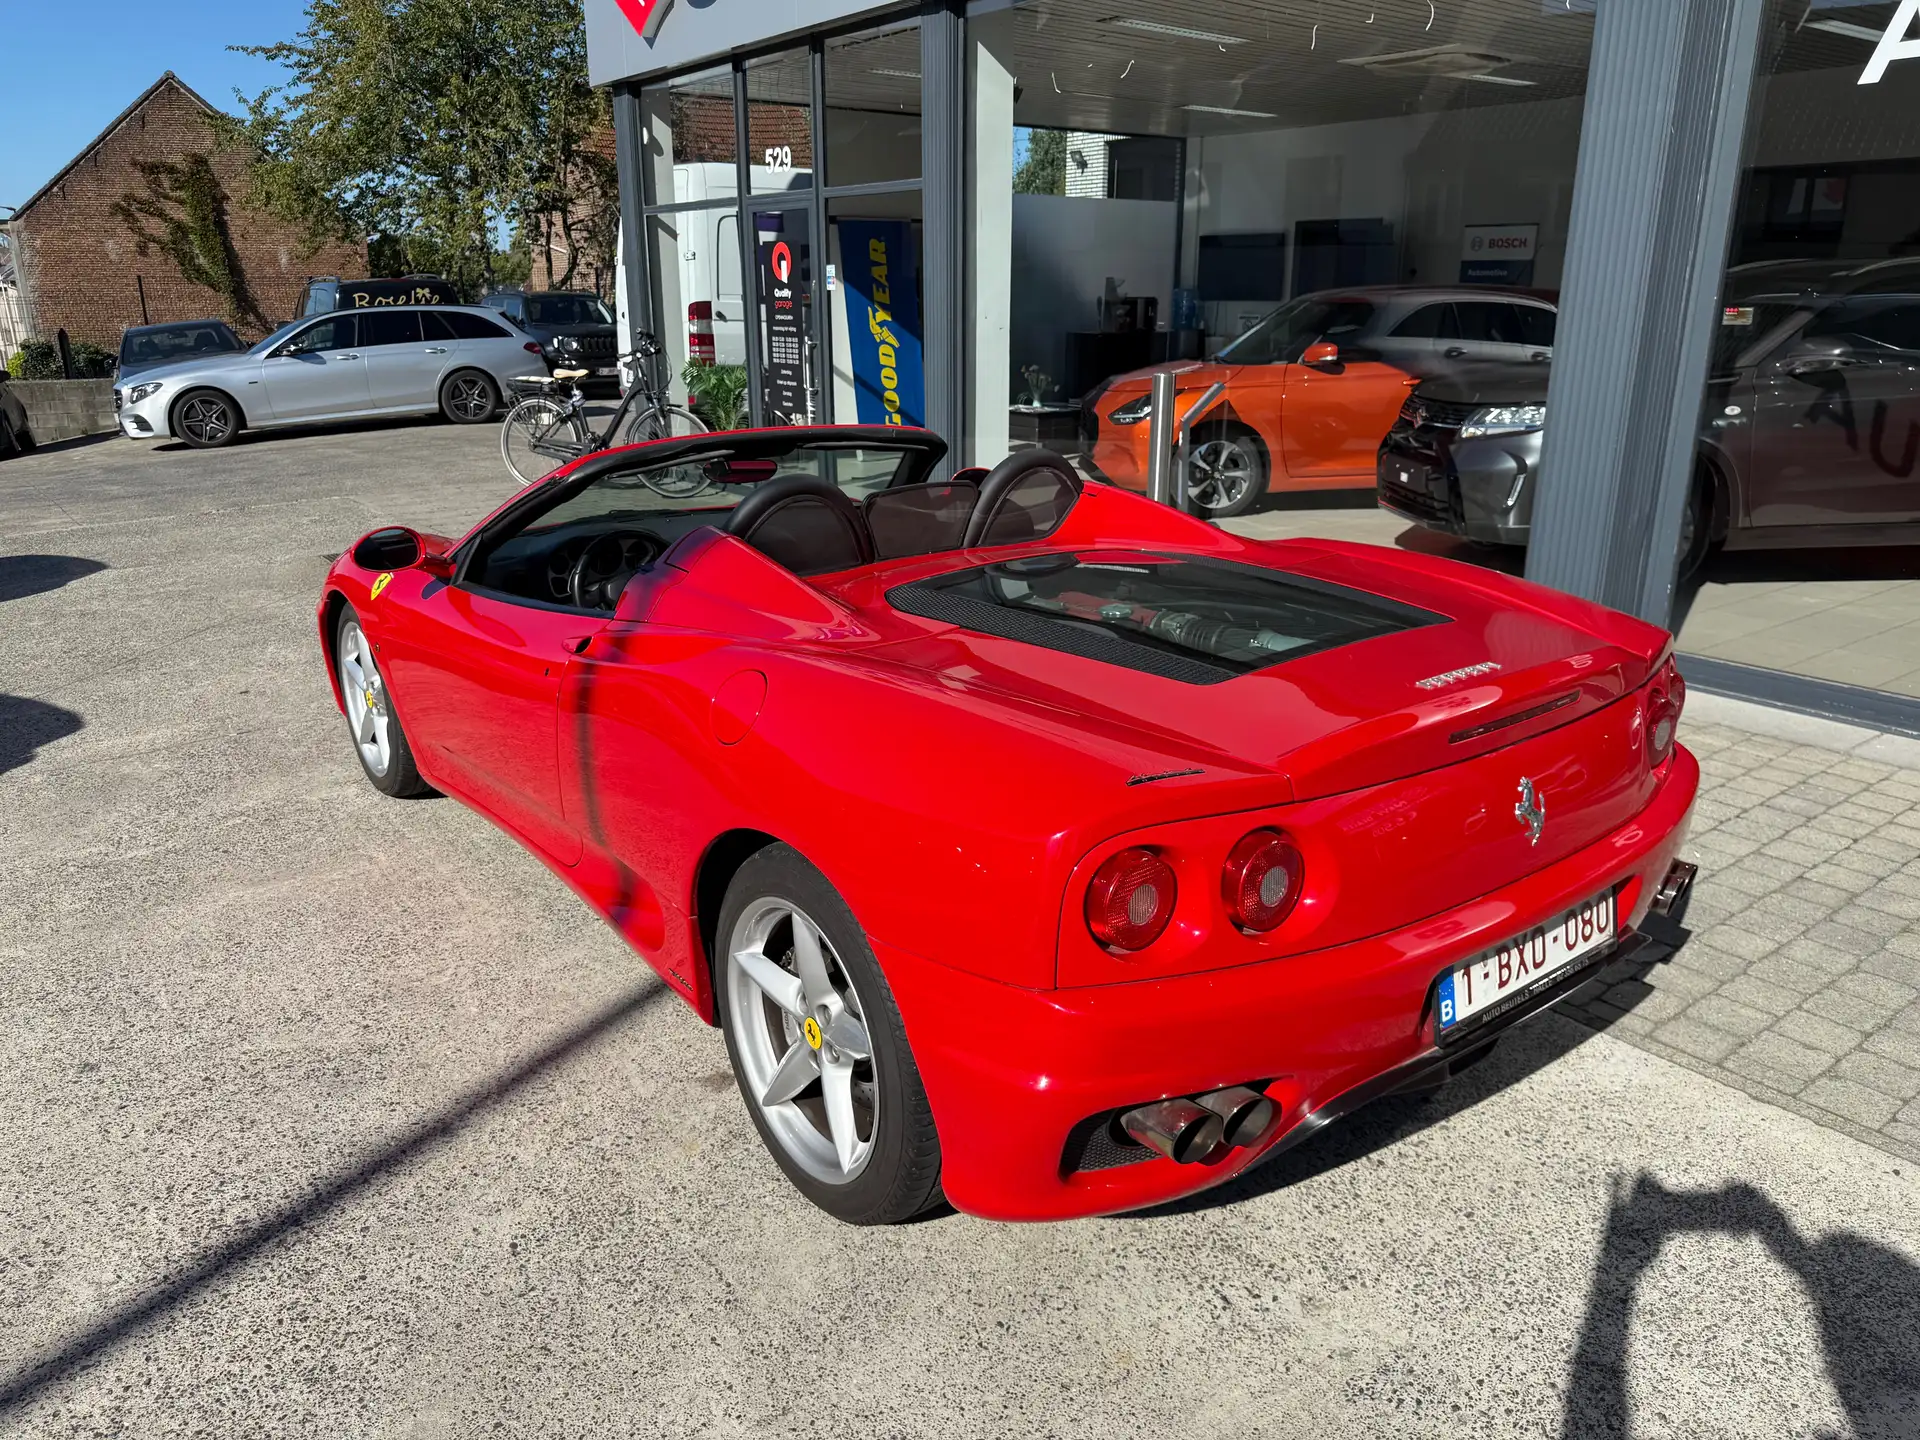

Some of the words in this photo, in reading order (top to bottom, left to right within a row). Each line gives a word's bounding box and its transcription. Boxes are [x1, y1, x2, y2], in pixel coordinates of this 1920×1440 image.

[765, 145, 792, 175] 529
[1488, 237, 1528, 249] BOSCH
[1467, 268, 1508, 277] Automotive
[1461, 894, 1609, 1007] 1-BXO-080
[1441, 999, 1453, 1022] B
[1482, 1006, 1500, 1024] AUTO
